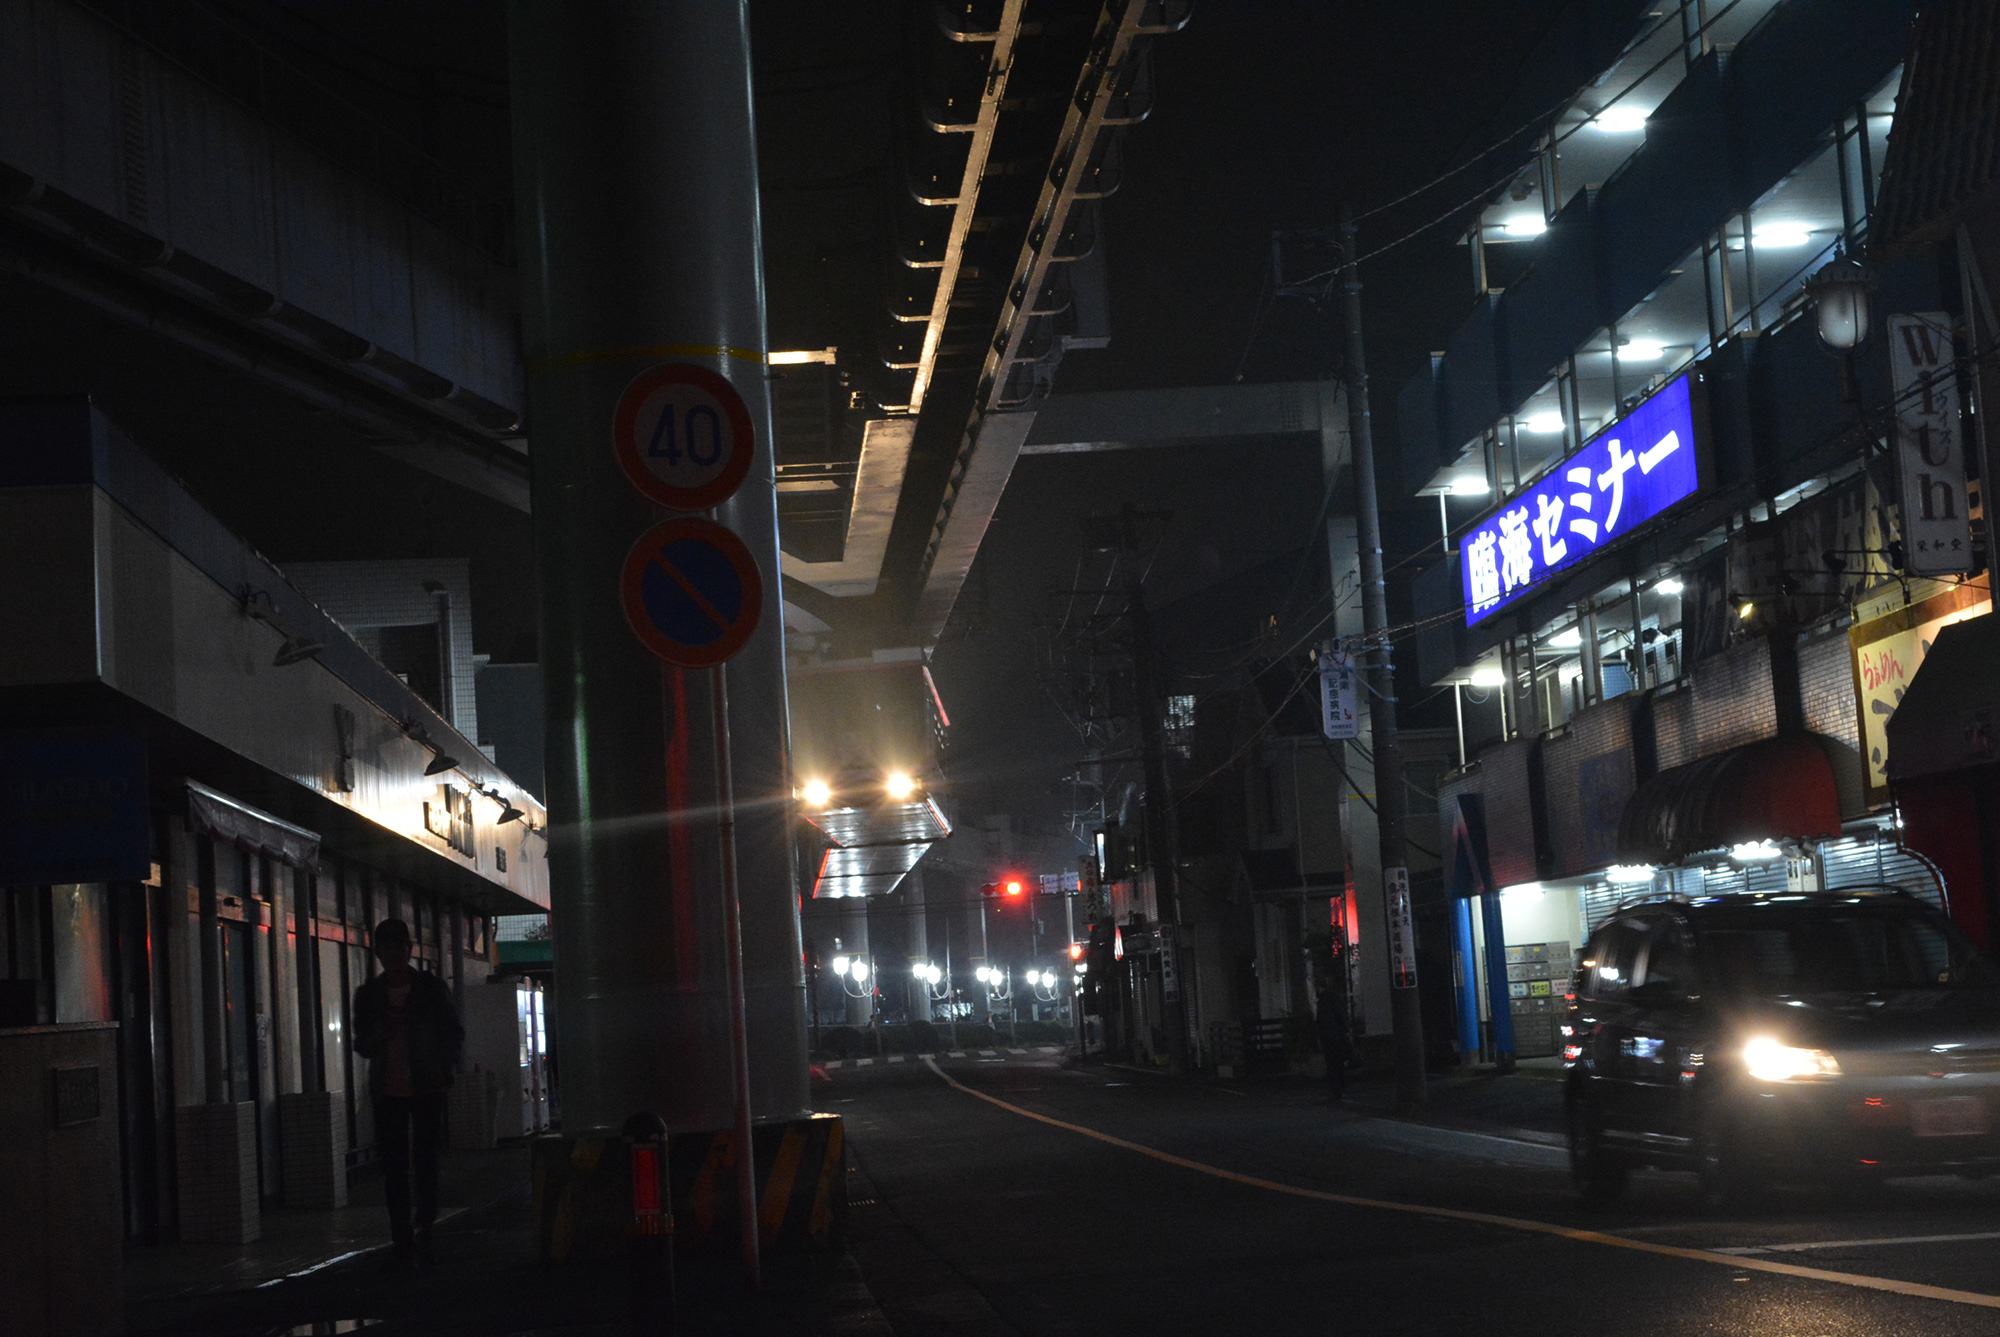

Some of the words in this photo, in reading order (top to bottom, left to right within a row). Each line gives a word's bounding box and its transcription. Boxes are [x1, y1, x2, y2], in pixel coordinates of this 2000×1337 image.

[649, 404, 721, 467] 40
[1468, 430, 1679, 614] 臨海セミナー
